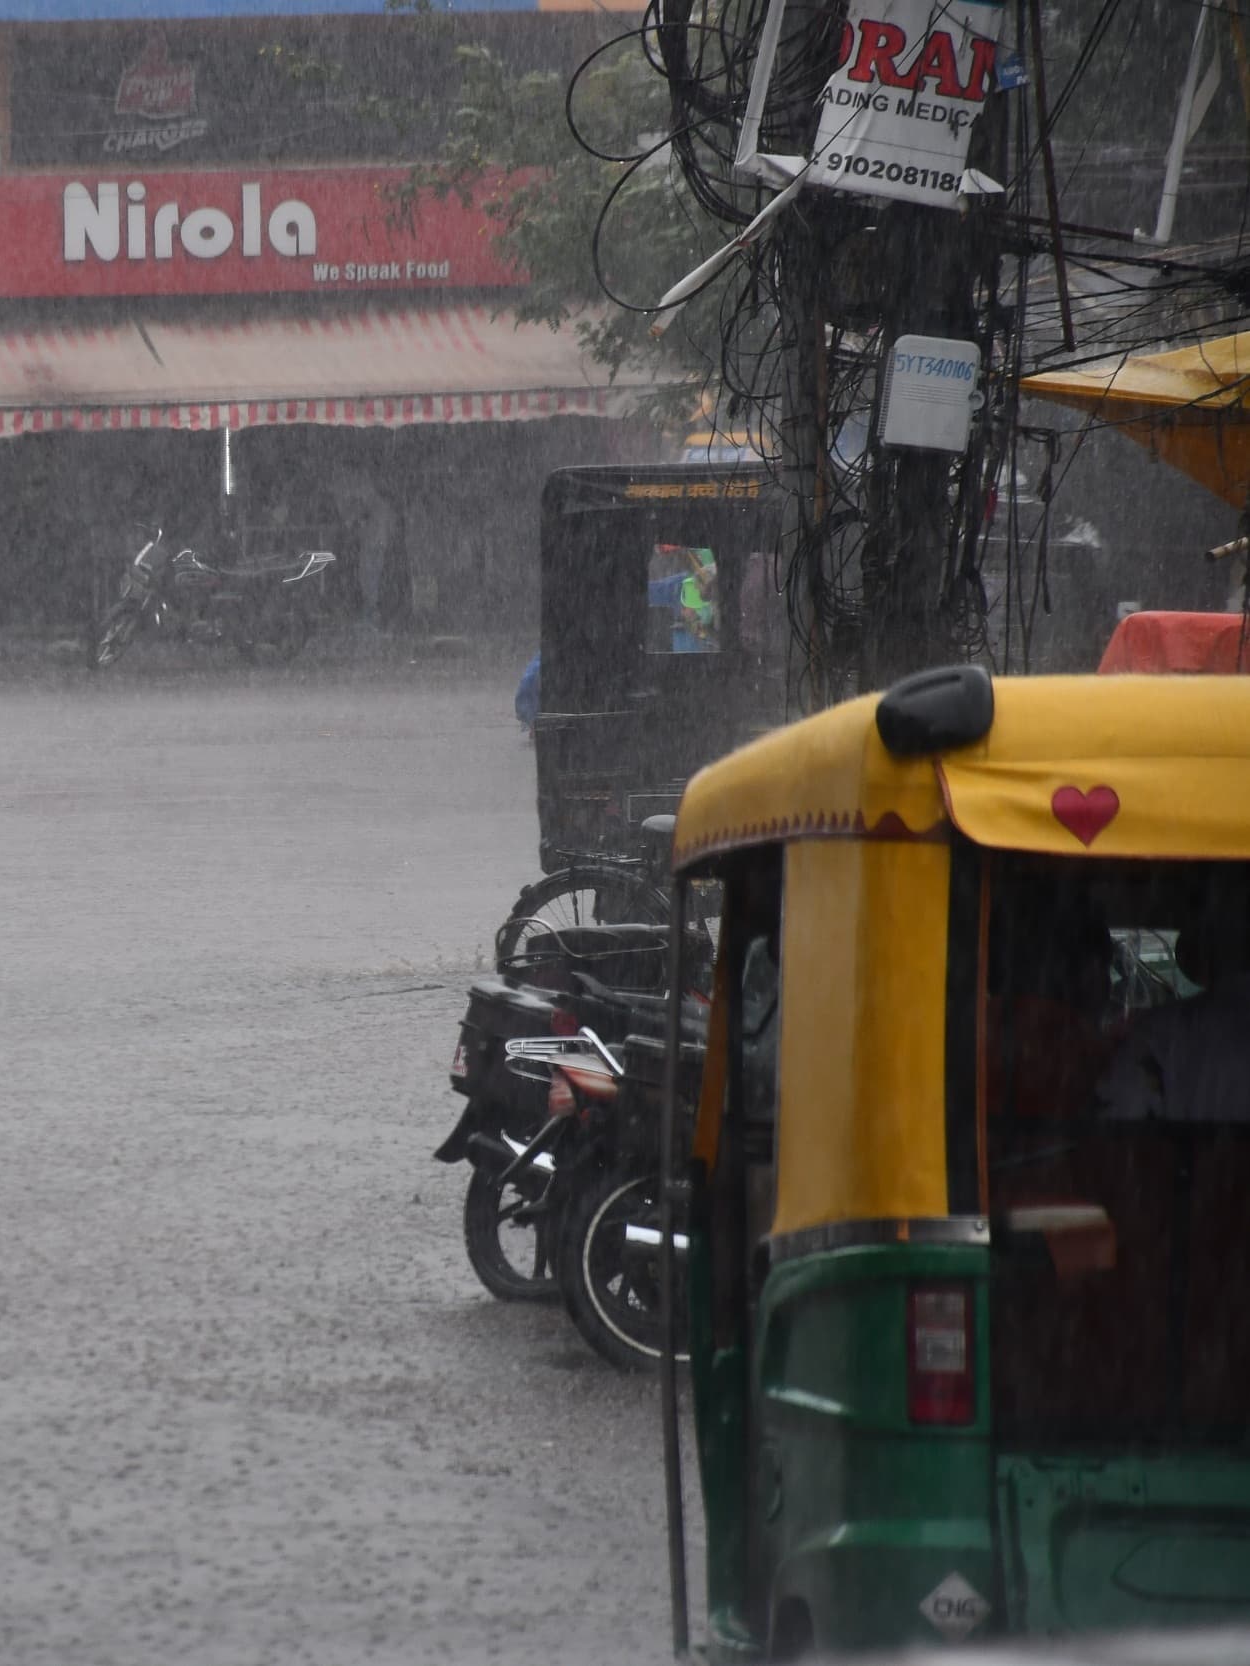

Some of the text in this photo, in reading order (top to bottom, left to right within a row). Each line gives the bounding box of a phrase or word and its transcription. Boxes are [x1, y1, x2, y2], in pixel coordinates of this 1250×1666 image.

[63, 181, 317, 262] Nirola
[312, 259, 451, 283] We Speak Food
